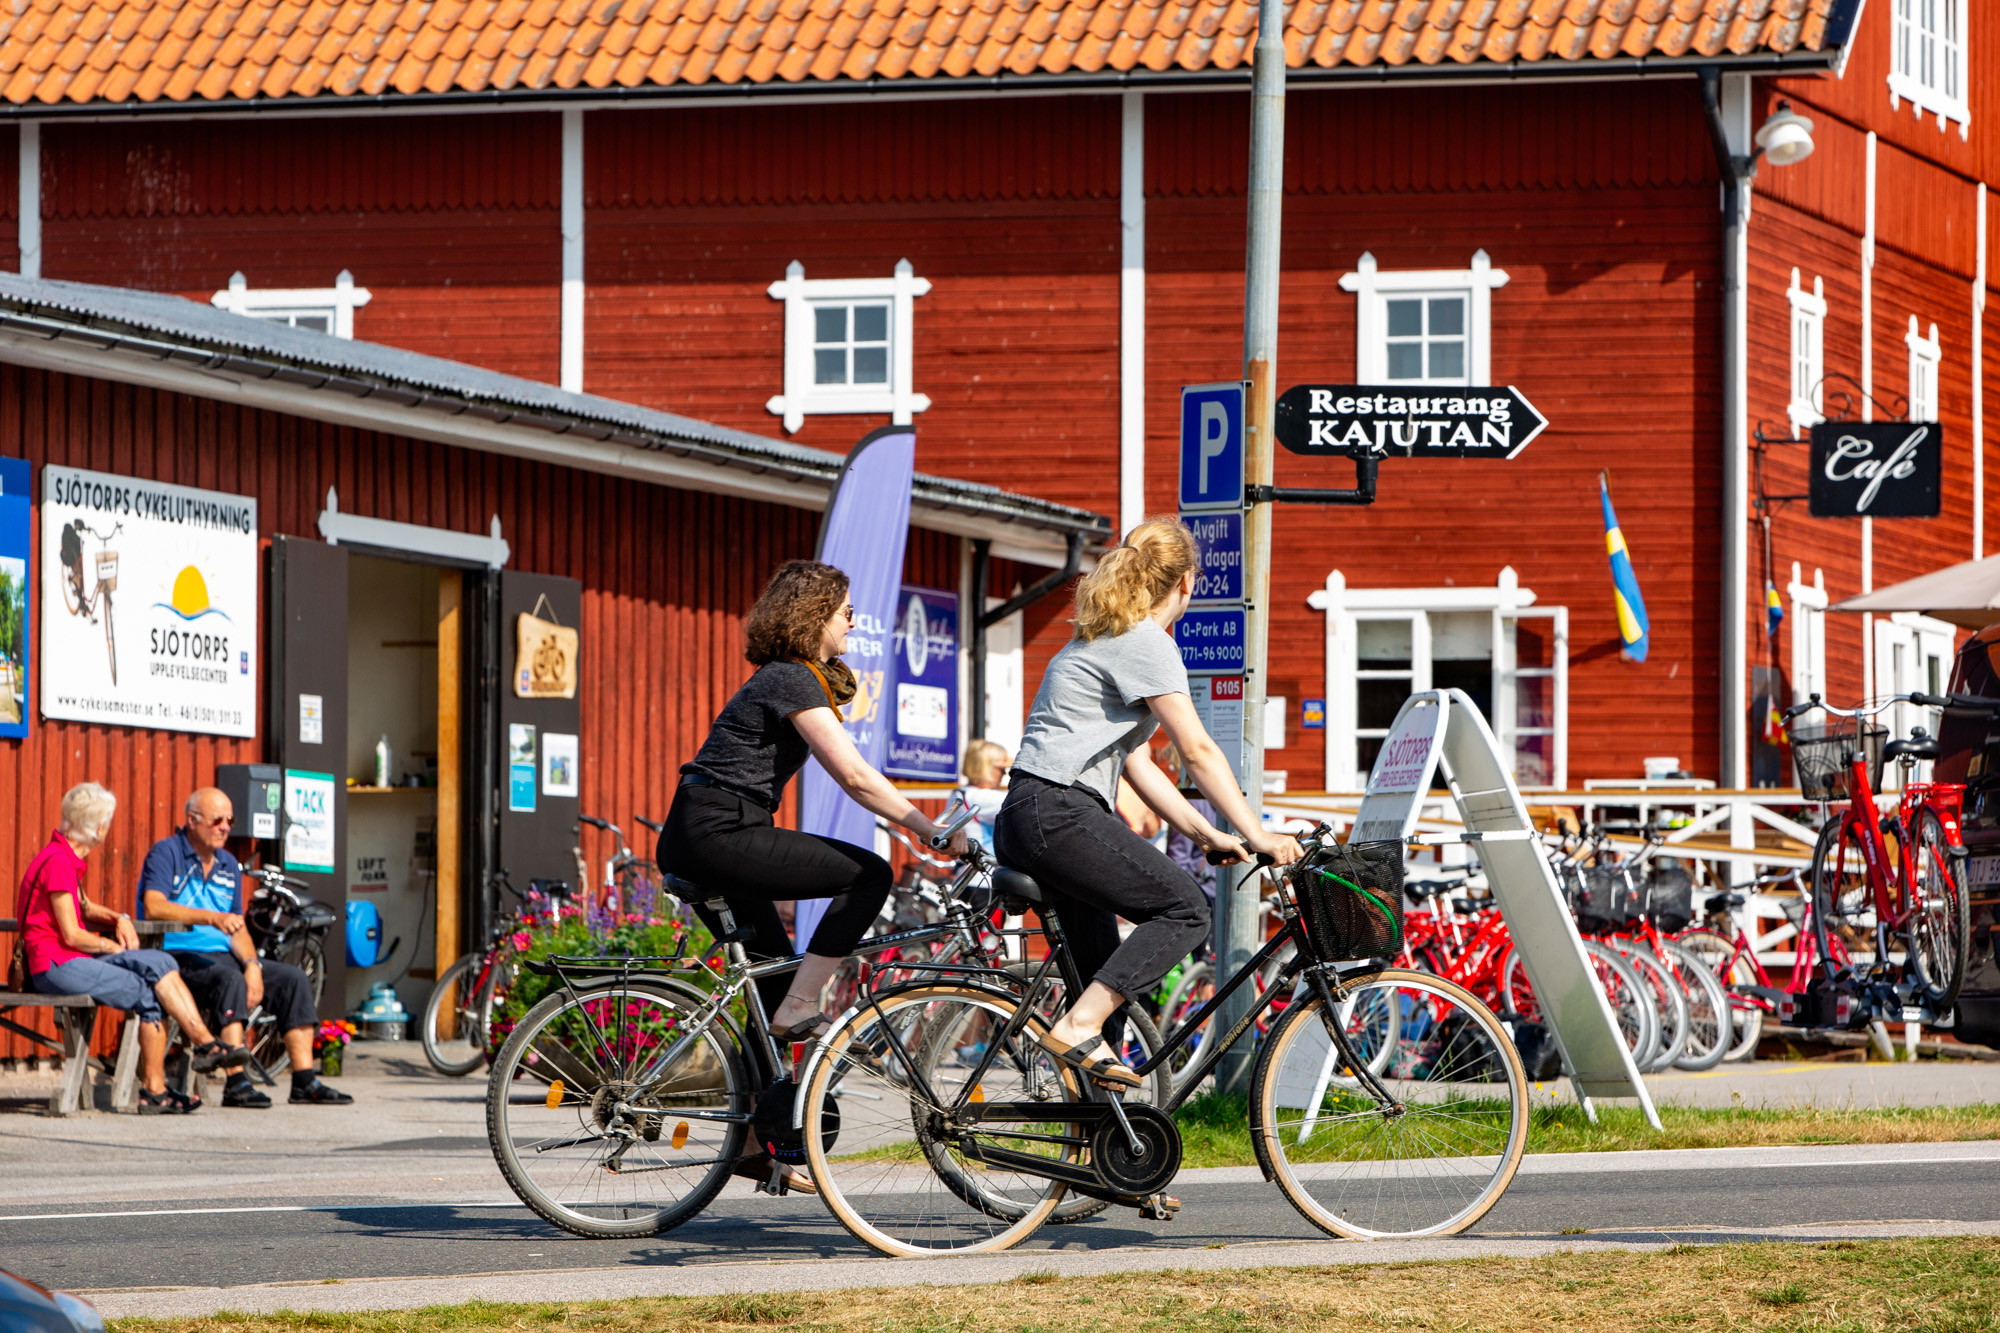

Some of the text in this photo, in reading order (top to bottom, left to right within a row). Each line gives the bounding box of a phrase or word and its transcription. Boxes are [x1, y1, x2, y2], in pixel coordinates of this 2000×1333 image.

[1308, 389, 1511, 422] Restaurang
[1198, 401, 1229, 495] P
[1308, 419, 1513, 452] KAJUTAN
[1825, 426, 1929, 512] Café
[55, 473, 250, 534] SJÖTORPS CYKELUTHYRNING
[1193, 518, 1228, 544] Avgift
[1205, 547, 1241, 571] dagar
[151, 624, 228, 662] SJÖTORPS
[1182, 621, 1237, 637] Q-Park AB
[150, 662, 228, 684] UPPLEVELSECENTER
[1216, 680, 1240, 695] 6105
[1384, 733, 1433, 767] SJÖTORPS
[295, 788, 325, 814] TACK
